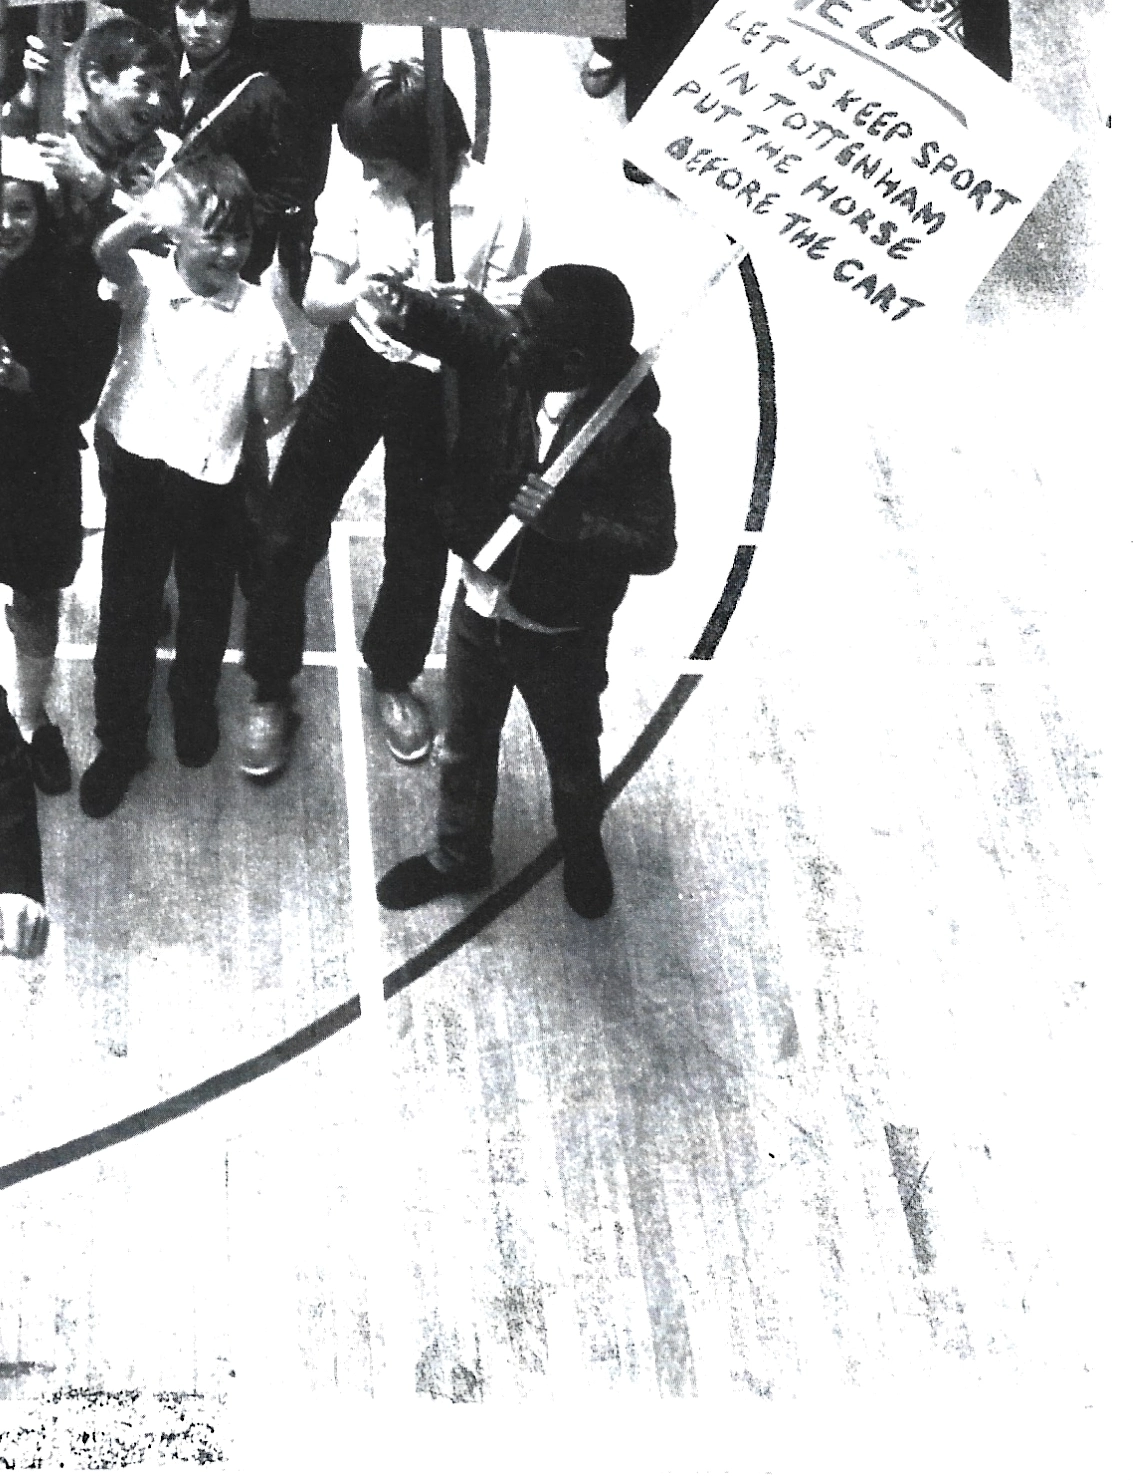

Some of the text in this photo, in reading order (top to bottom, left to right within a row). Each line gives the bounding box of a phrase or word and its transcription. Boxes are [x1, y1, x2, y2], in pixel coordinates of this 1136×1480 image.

[672, 79, 923, 261] PUT THE HORSE
[718, 62, 947, 235] IN TOTTENHAM
[725, 10, 1023, 215] LET US KEEP SPORT
[664, 135, 926, 322] BEFORE THE CART
